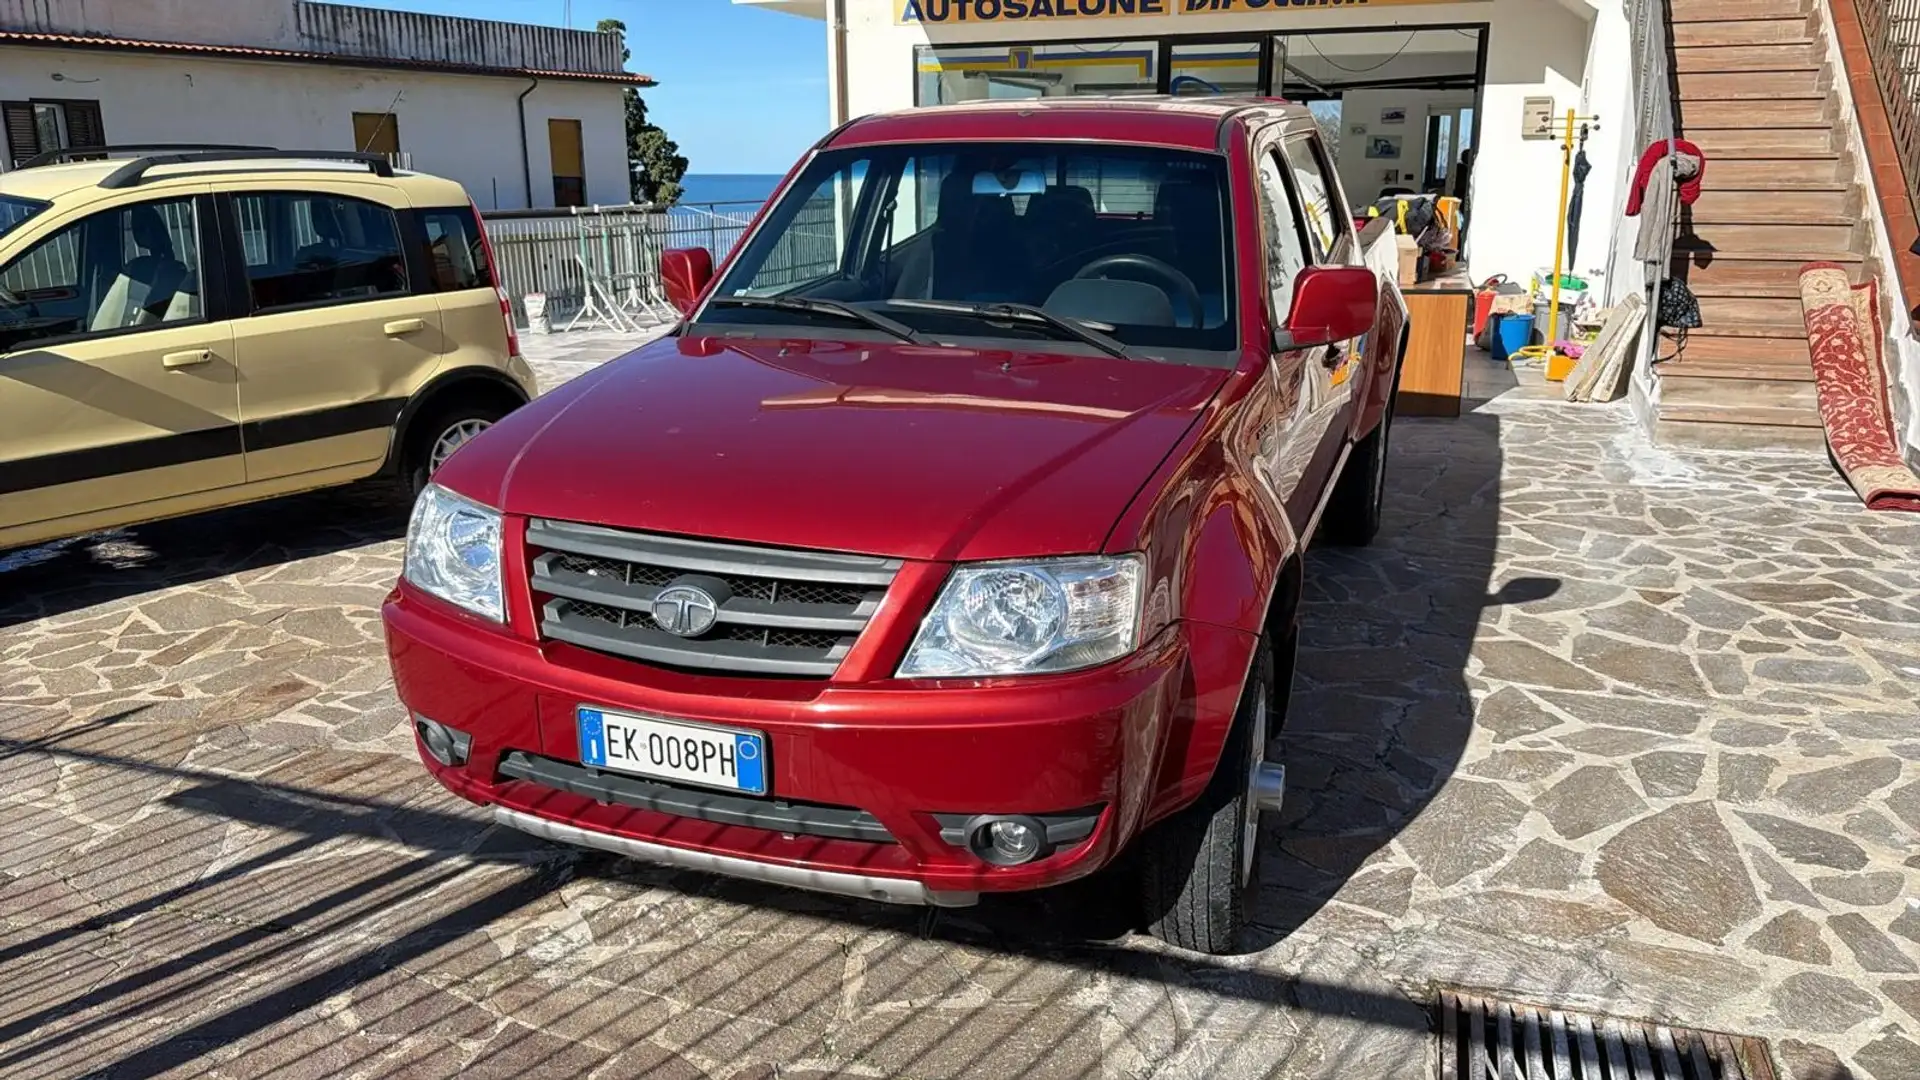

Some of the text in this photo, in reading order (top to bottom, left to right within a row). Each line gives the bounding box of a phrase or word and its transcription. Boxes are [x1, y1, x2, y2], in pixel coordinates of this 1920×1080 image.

[901, 0, 1163, 22] AUTOSALONE
[606, 725, 736, 777] EK 008PH
